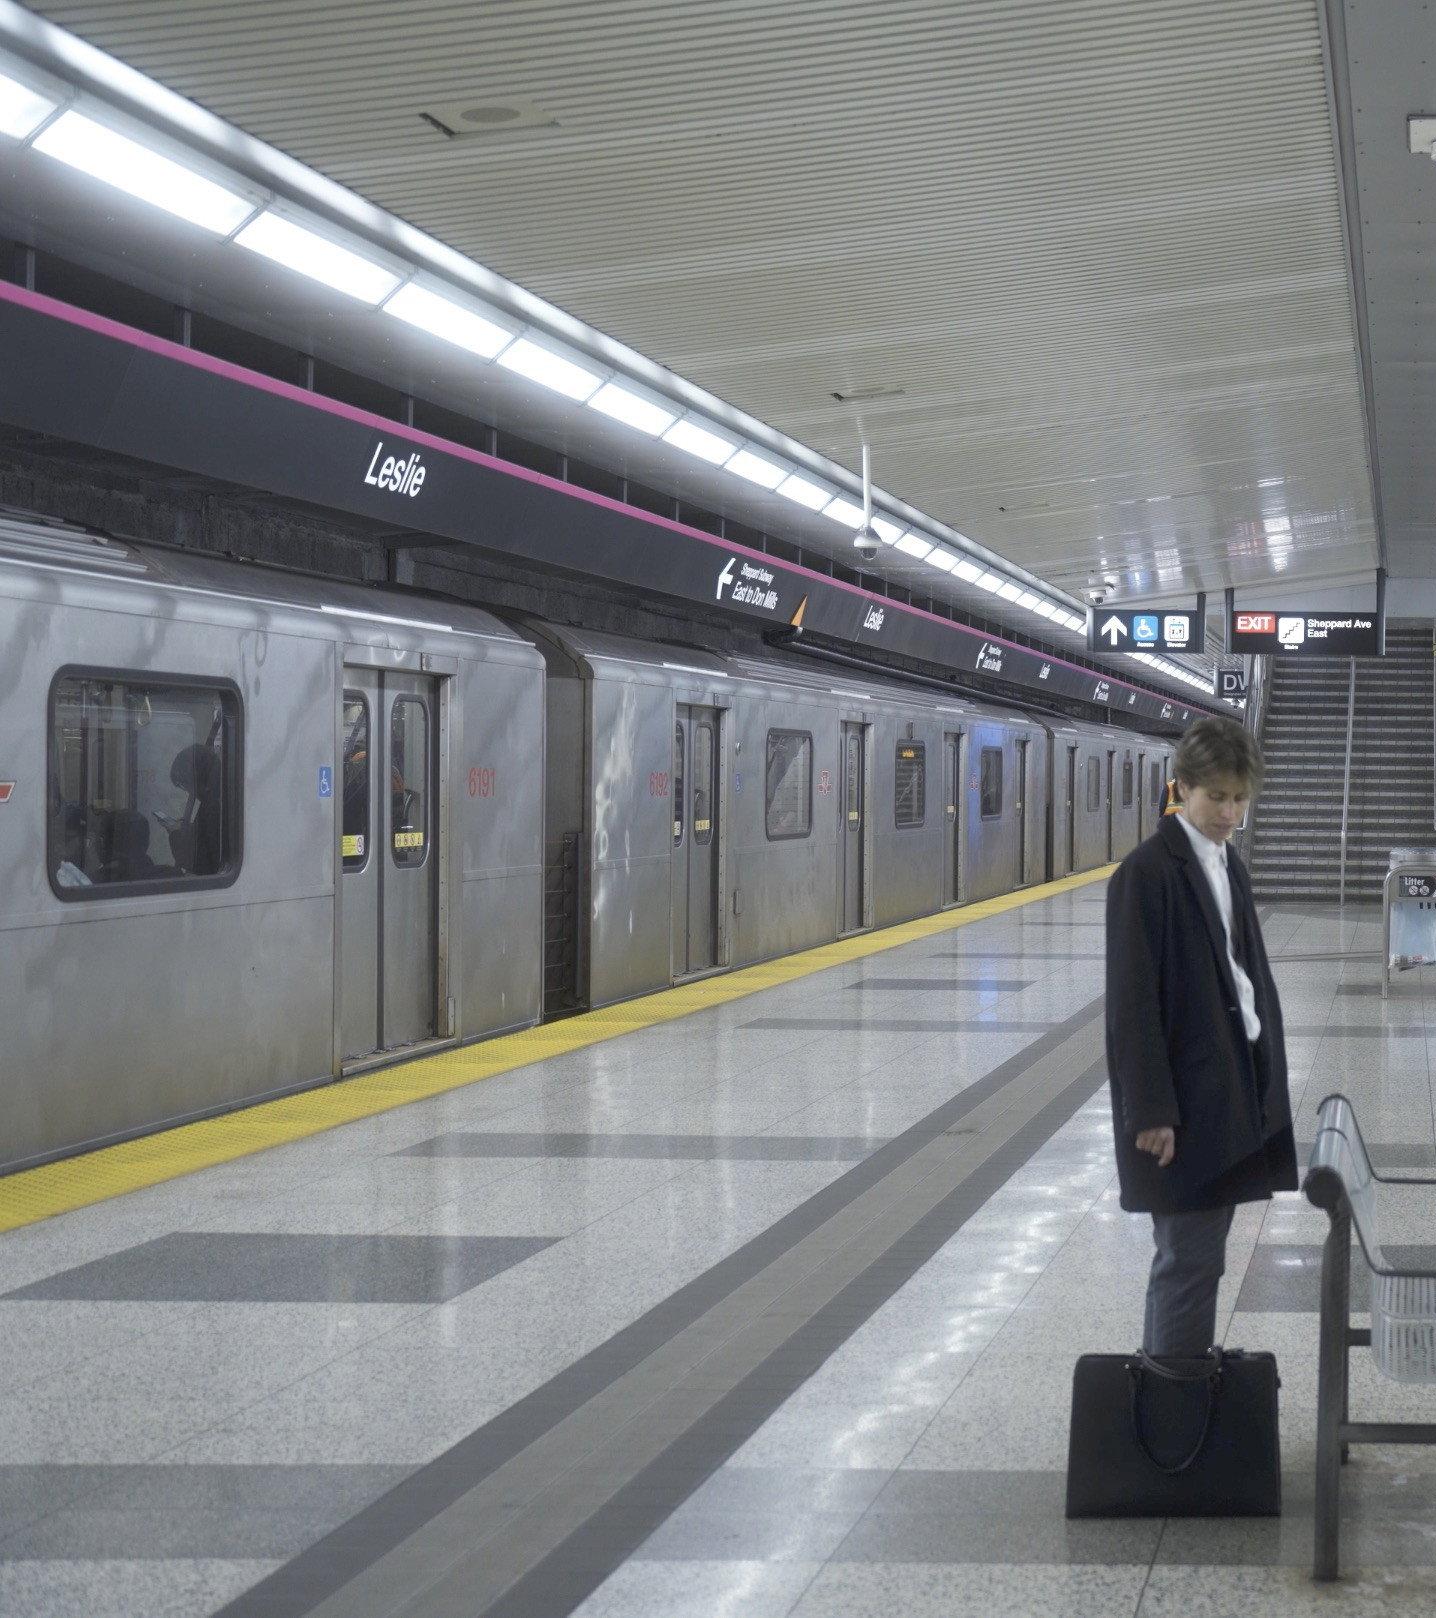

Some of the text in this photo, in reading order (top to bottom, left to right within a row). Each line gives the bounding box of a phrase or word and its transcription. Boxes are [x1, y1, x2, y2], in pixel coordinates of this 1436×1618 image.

[364, 442, 427, 497] Leslie
[732, 581, 749, 602] East
[751, 587, 766, 606] Don
[863, 605, 885, 632] Leslie
[1237, 616, 1272, 630] EXIT
[1307, 618, 1372, 630] Sheppard Ave
[1307, 628, 1328, 638] East
[468, 767, 495, 797] 6191
[1404, 876, 1424, 886] Litter
